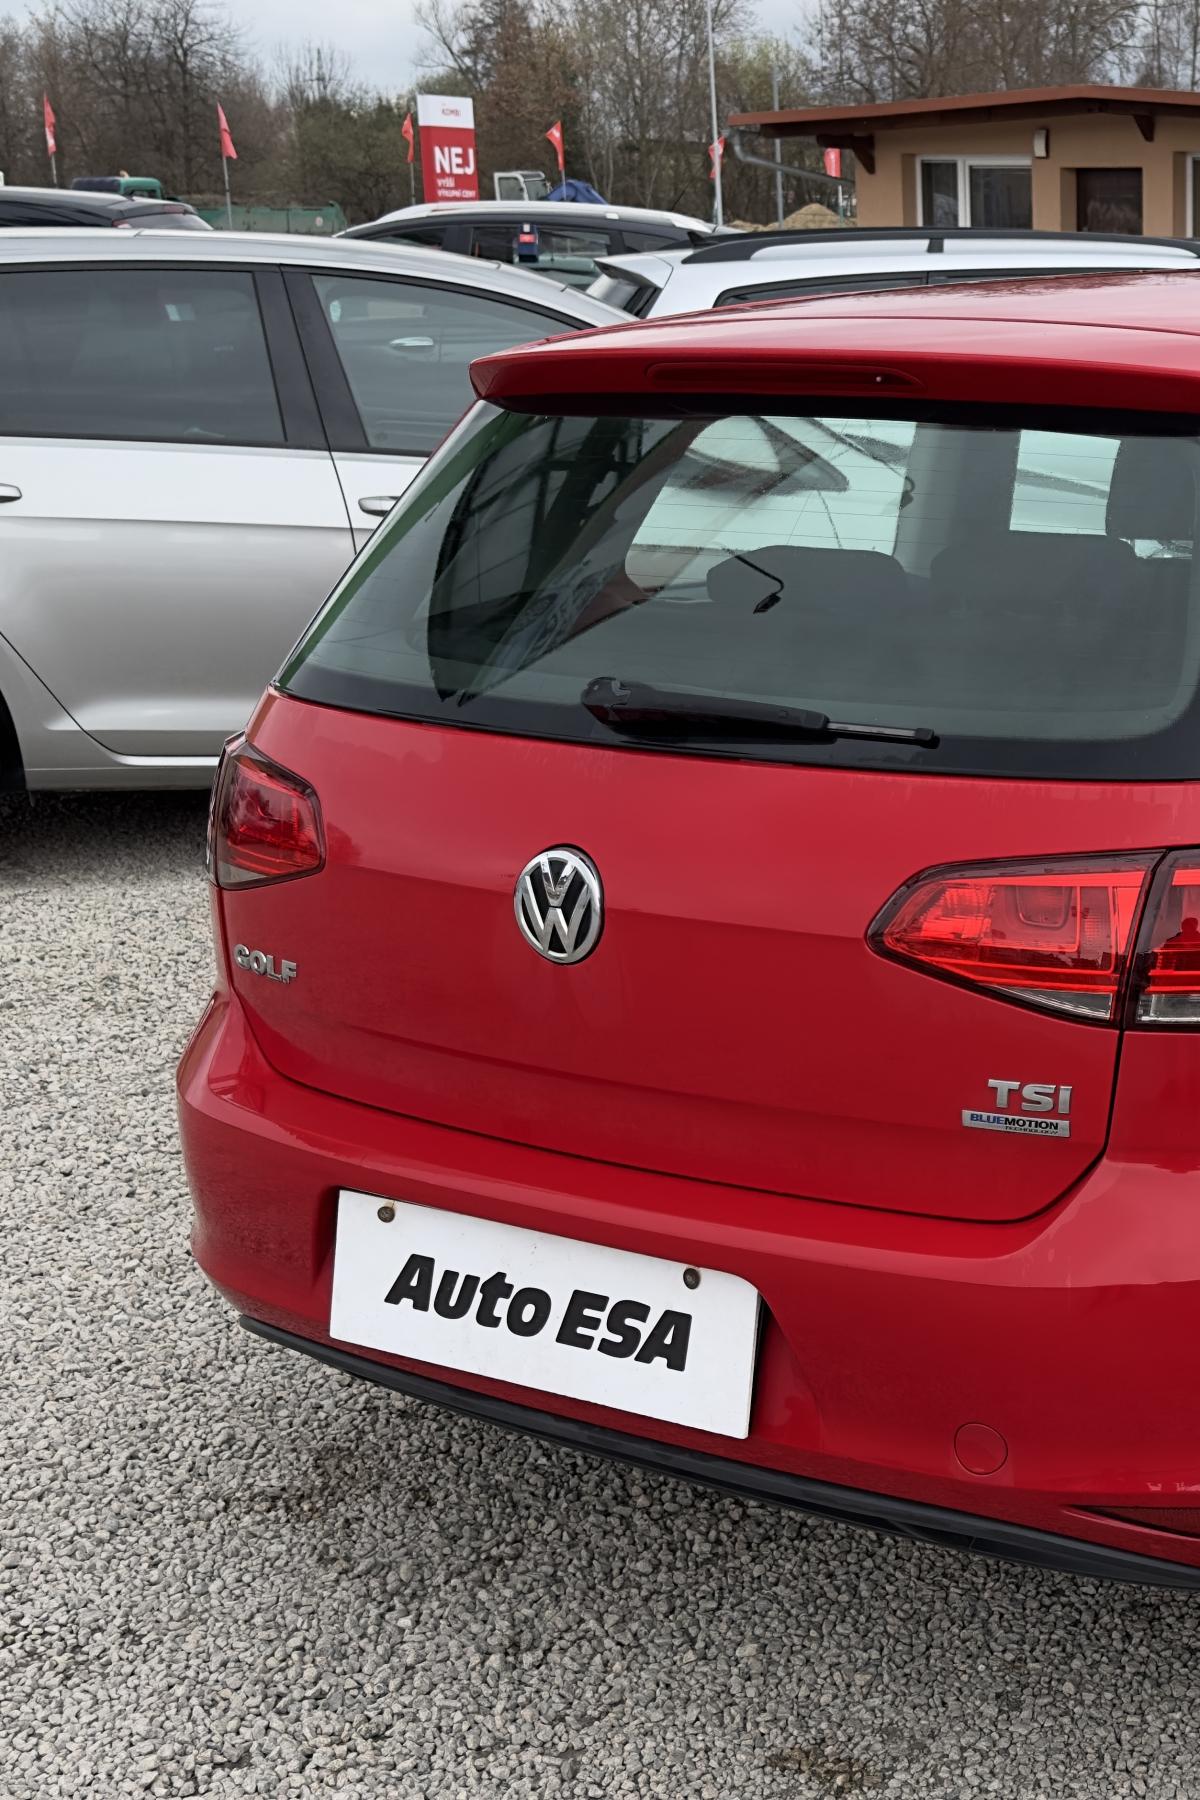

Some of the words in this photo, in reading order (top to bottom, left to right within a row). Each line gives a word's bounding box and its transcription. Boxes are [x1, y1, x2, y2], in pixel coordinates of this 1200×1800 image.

[434, 146, 475, 175] NEJ
[233, 944, 297, 985] GOLF
[987, 1079, 1073, 1114] TSI
[970, 1113, 1059, 1131] BLUEMOTION
[384, 1253, 552, 1337] Auto
[555, 1289, 693, 1372] ESA
